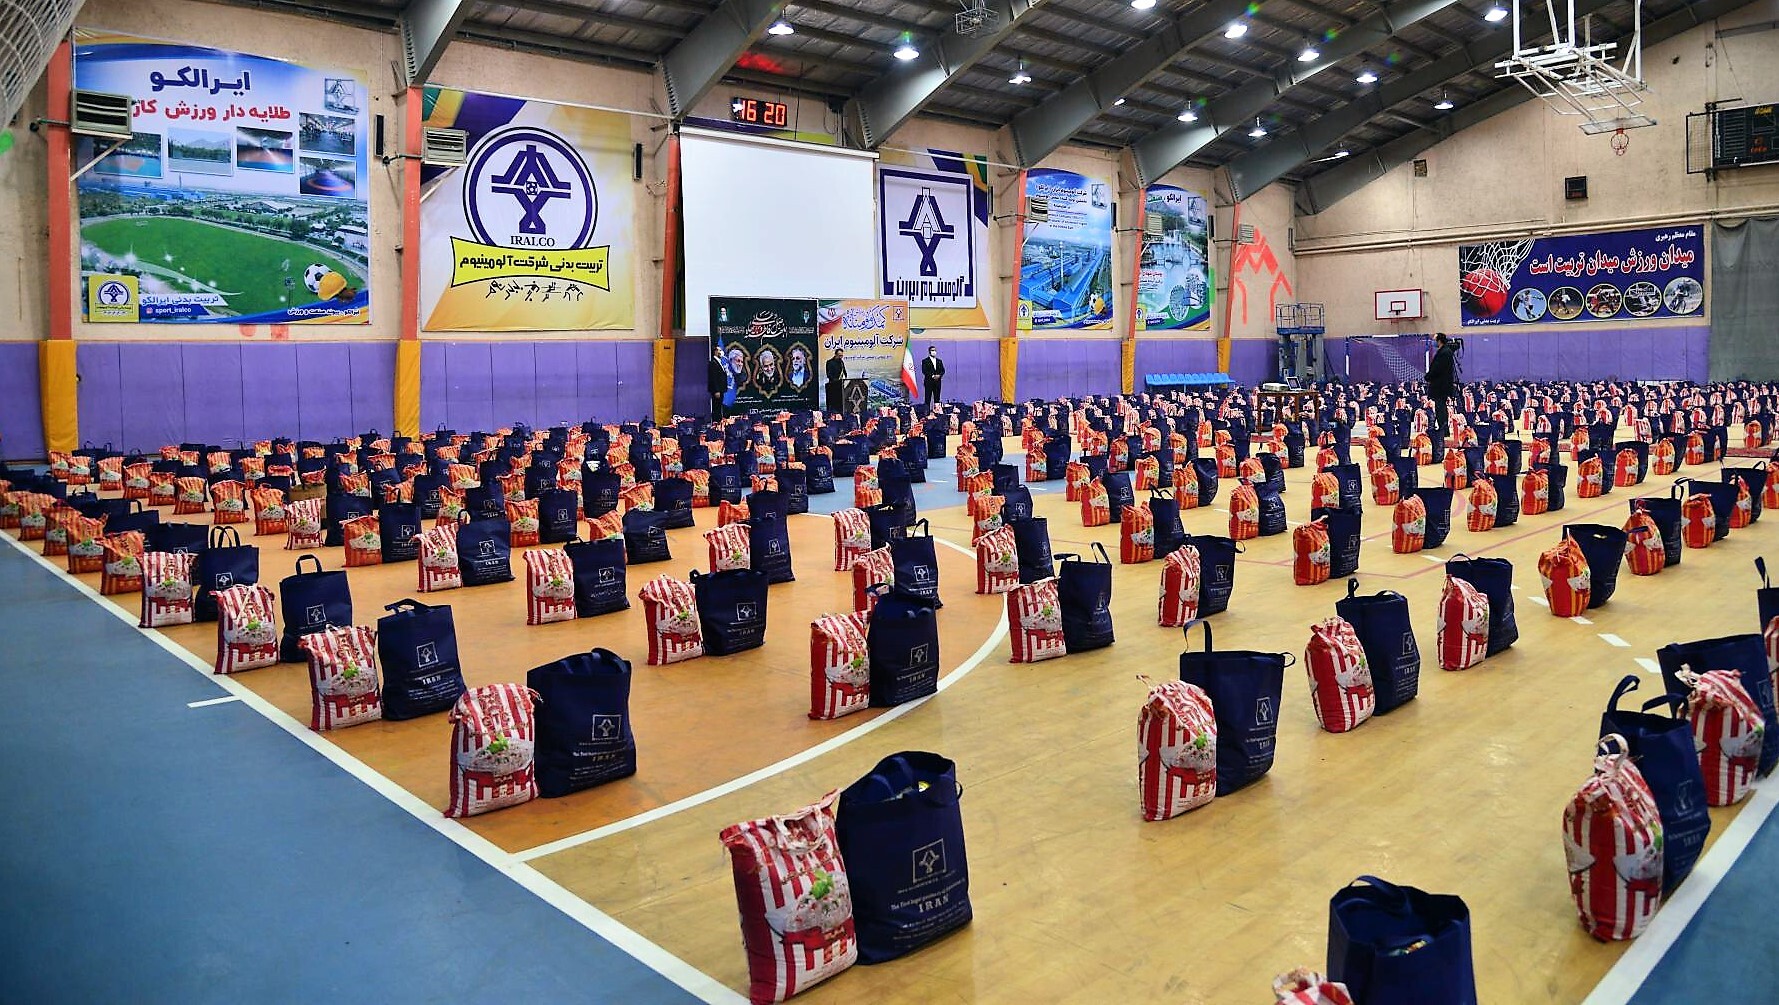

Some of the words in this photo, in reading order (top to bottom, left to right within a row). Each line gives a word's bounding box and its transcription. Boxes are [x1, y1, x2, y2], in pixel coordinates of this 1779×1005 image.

[150, 66, 250, 96] ایرالکو
[165, 101, 217, 120] ورزش
[223, 104, 246, 121] دار
[249, 106, 291, 122] طلایه
[741, 100, 757, 121] 16
[764, 102, 786, 126] 20
[510, 235, 555, 248] IRALCO
[514, 255, 549, 271] شرکت
[549, 257, 574, 272] بدنی
[1529, 254, 1554, 275] است
[1554, 251, 1586, 277] تربیت
[1586, 249, 1620, 276] میدان
[1621, 247, 1657, 273] ورزش
[1659, 243, 1695, 271] میدان
[575, 260, 604, 273] تربیت
[172, 295, 192, 305] بدنی
[193, 295, 219, 304] تربیت
[824, 335, 843, 350] ایران
[880, 334, 904, 348] شرکت
[919, 893, 949, 913] IRAN
